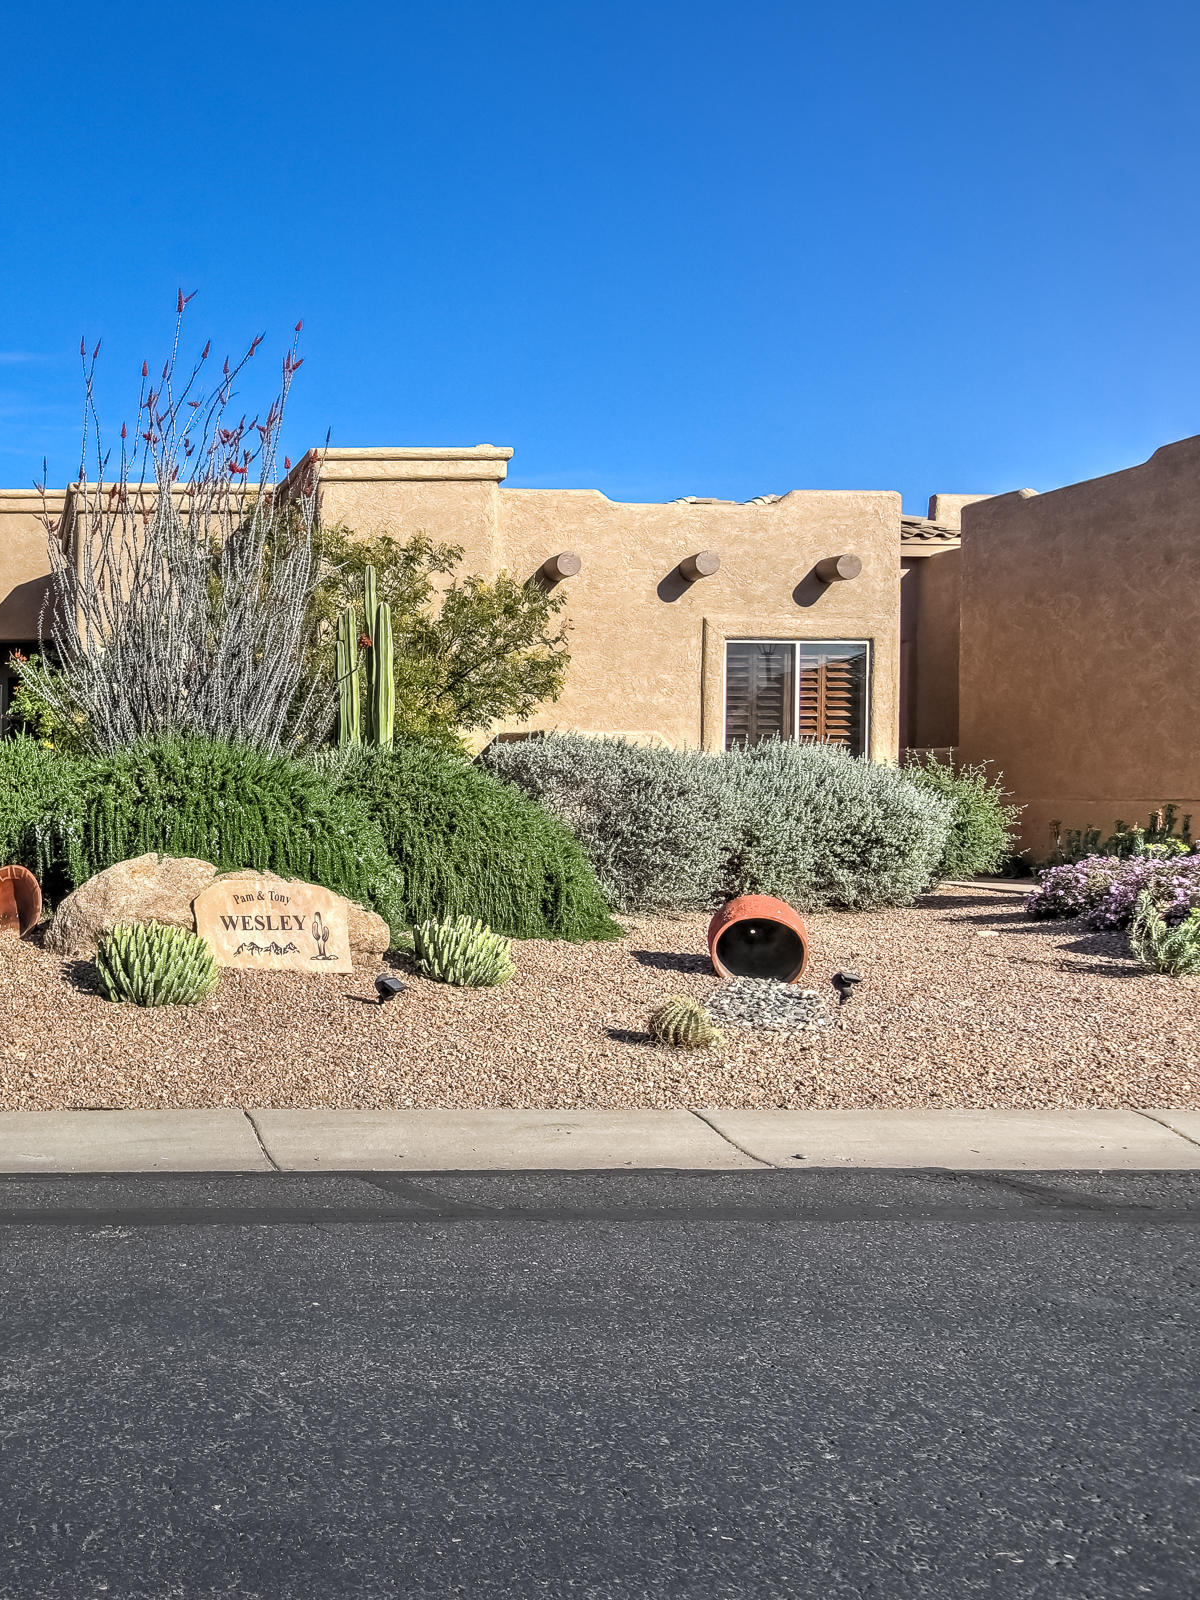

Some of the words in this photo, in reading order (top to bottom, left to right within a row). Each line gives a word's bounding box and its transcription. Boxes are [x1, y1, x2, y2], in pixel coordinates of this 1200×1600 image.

[233, 893, 255, 904] Pam
[257, 891, 265, 900] &
[268, 891, 291, 906] Tony
[220, 915, 306, 931] WESLEY
